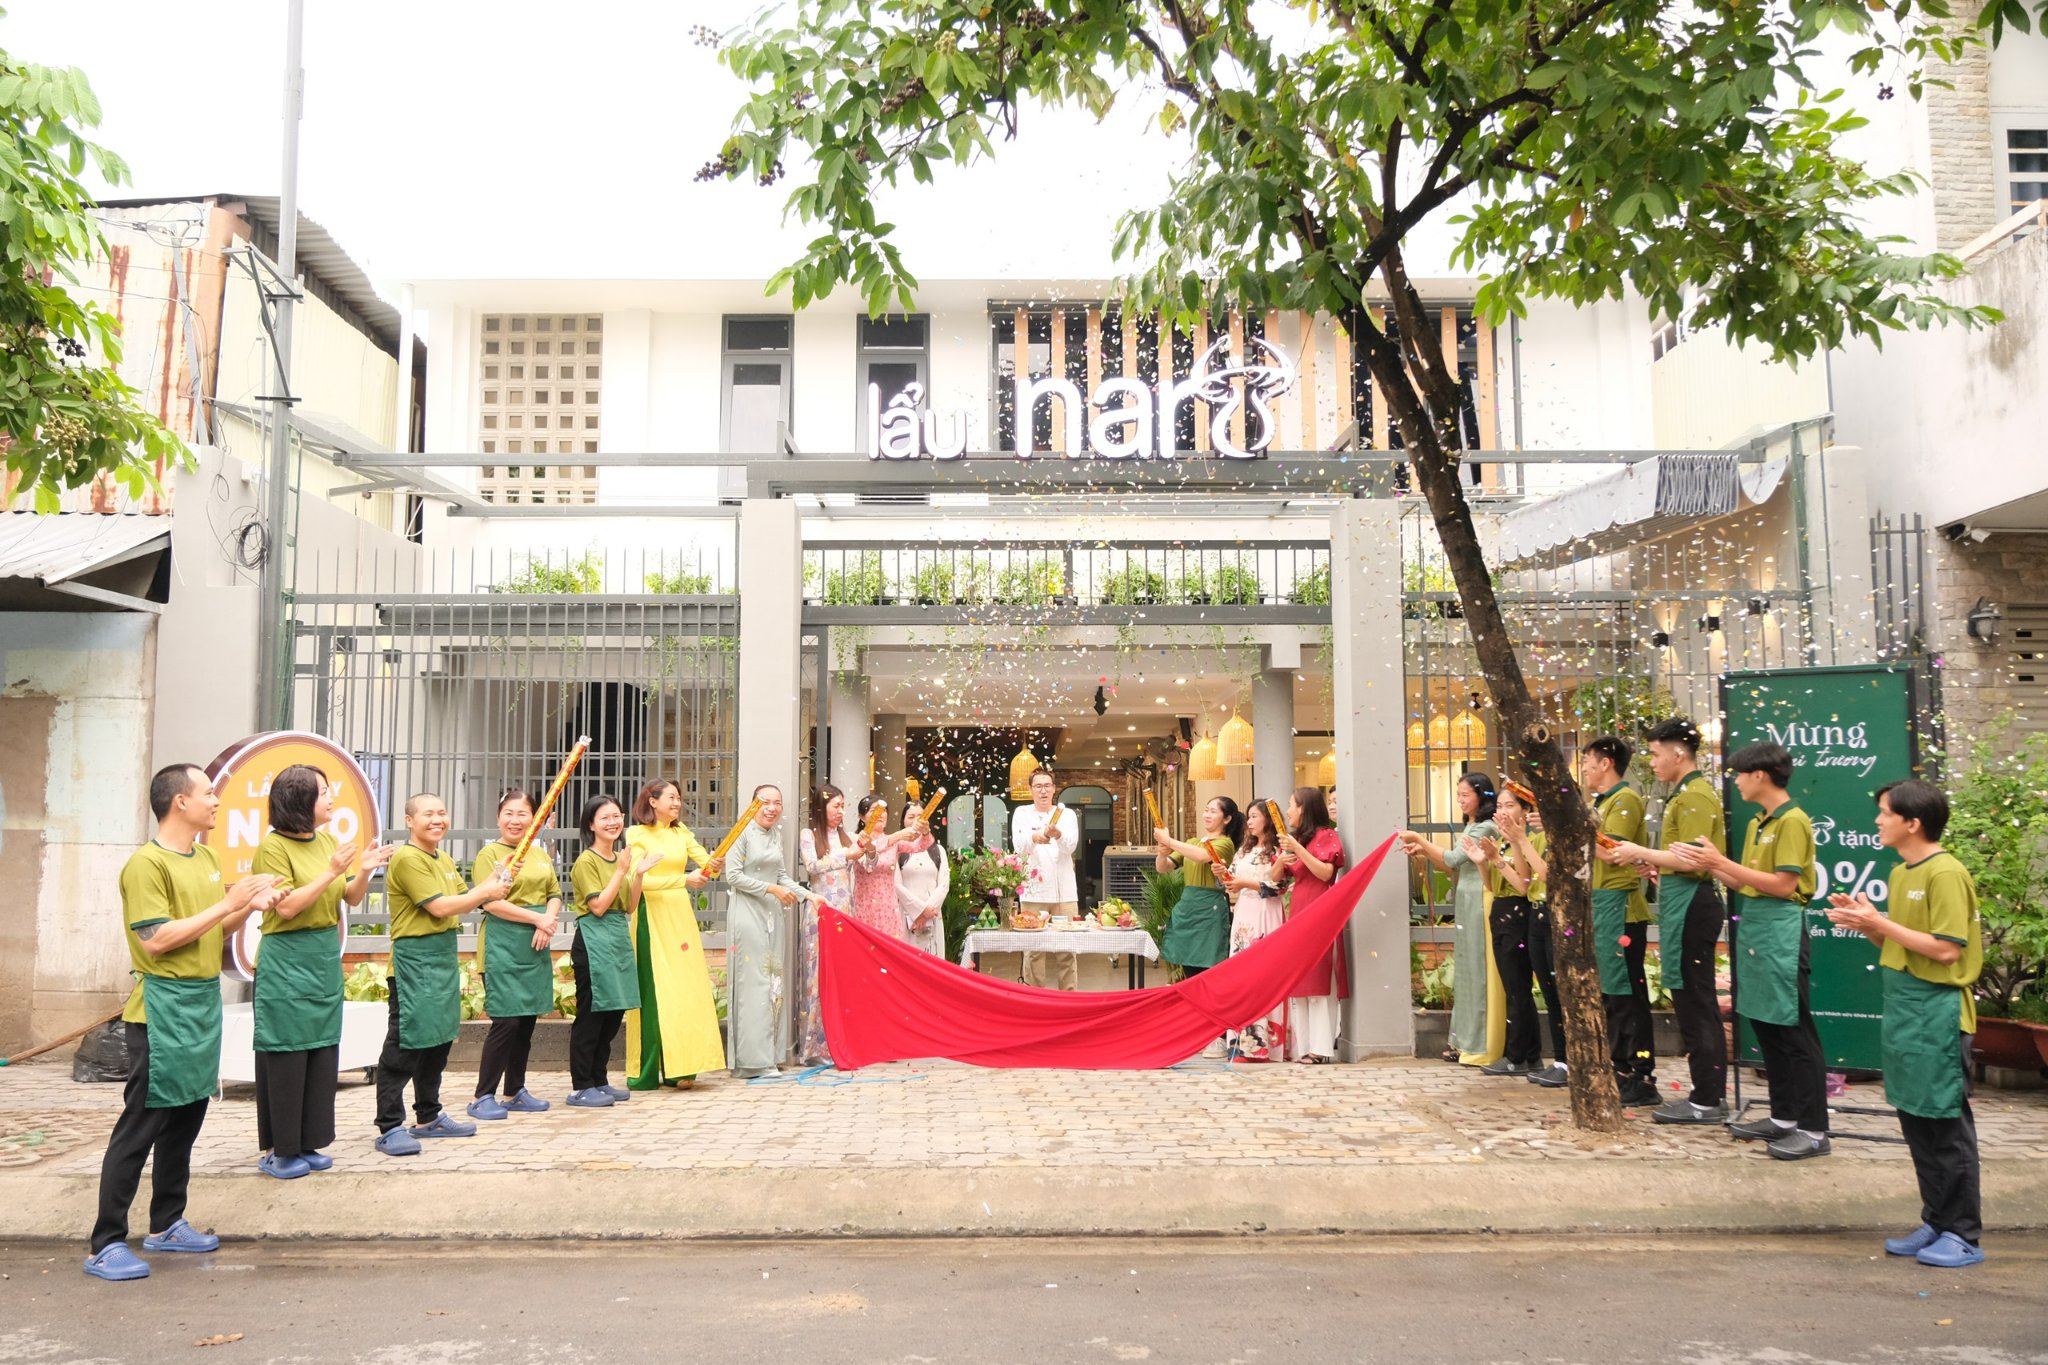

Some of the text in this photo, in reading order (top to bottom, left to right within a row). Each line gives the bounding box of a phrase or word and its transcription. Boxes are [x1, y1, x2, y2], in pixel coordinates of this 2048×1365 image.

[868, 382, 967, 459] lẩu
[1765, 722, 1868, 749] Mừng
[247, 772, 272, 798] LẨ
[1838, 830, 1884, 850] tặng
[1812, 861, 1888, 901] 0%
